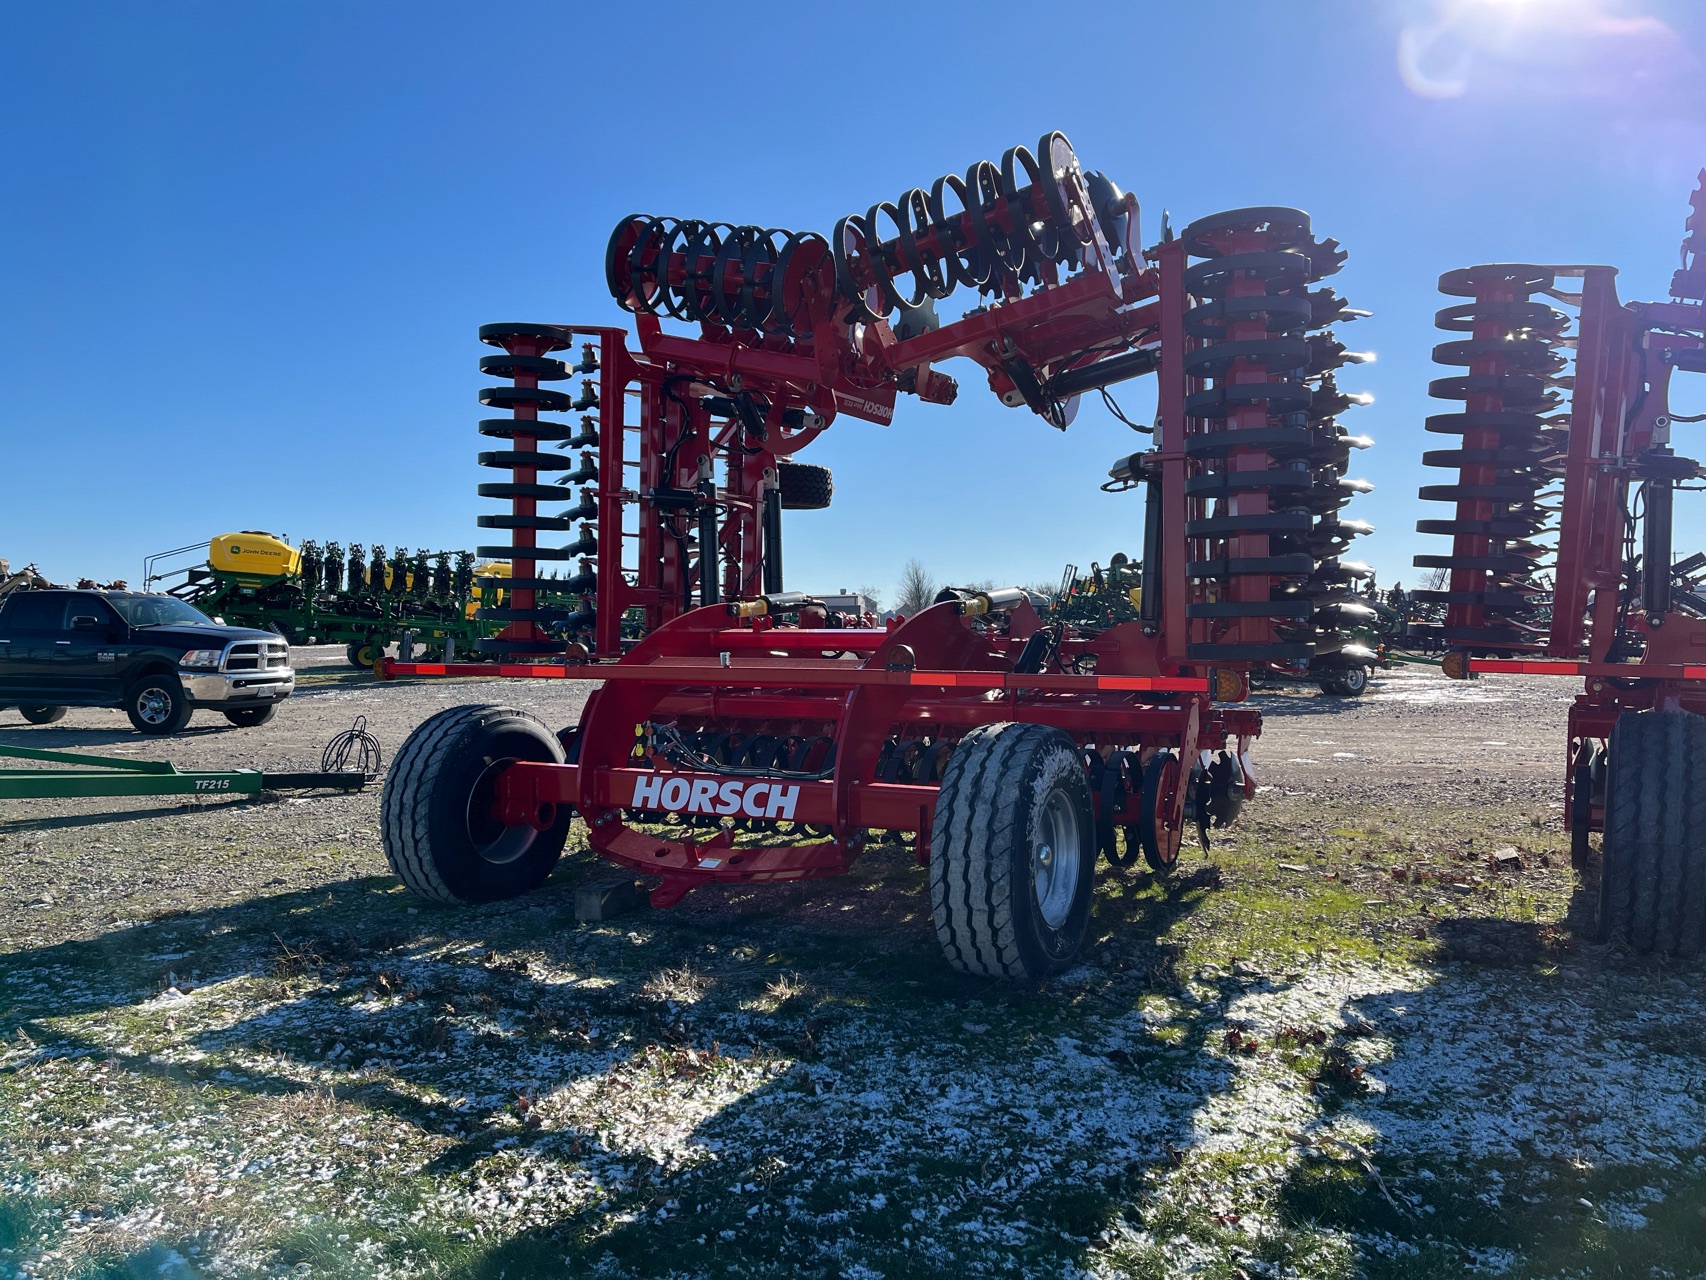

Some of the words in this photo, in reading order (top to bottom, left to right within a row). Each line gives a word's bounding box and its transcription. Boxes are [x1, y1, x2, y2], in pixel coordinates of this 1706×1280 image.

[863, 401, 894, 419] HORSCH
[195, 780, 230, 789] TF215
[632, 775, 800, 819] HORSCH
